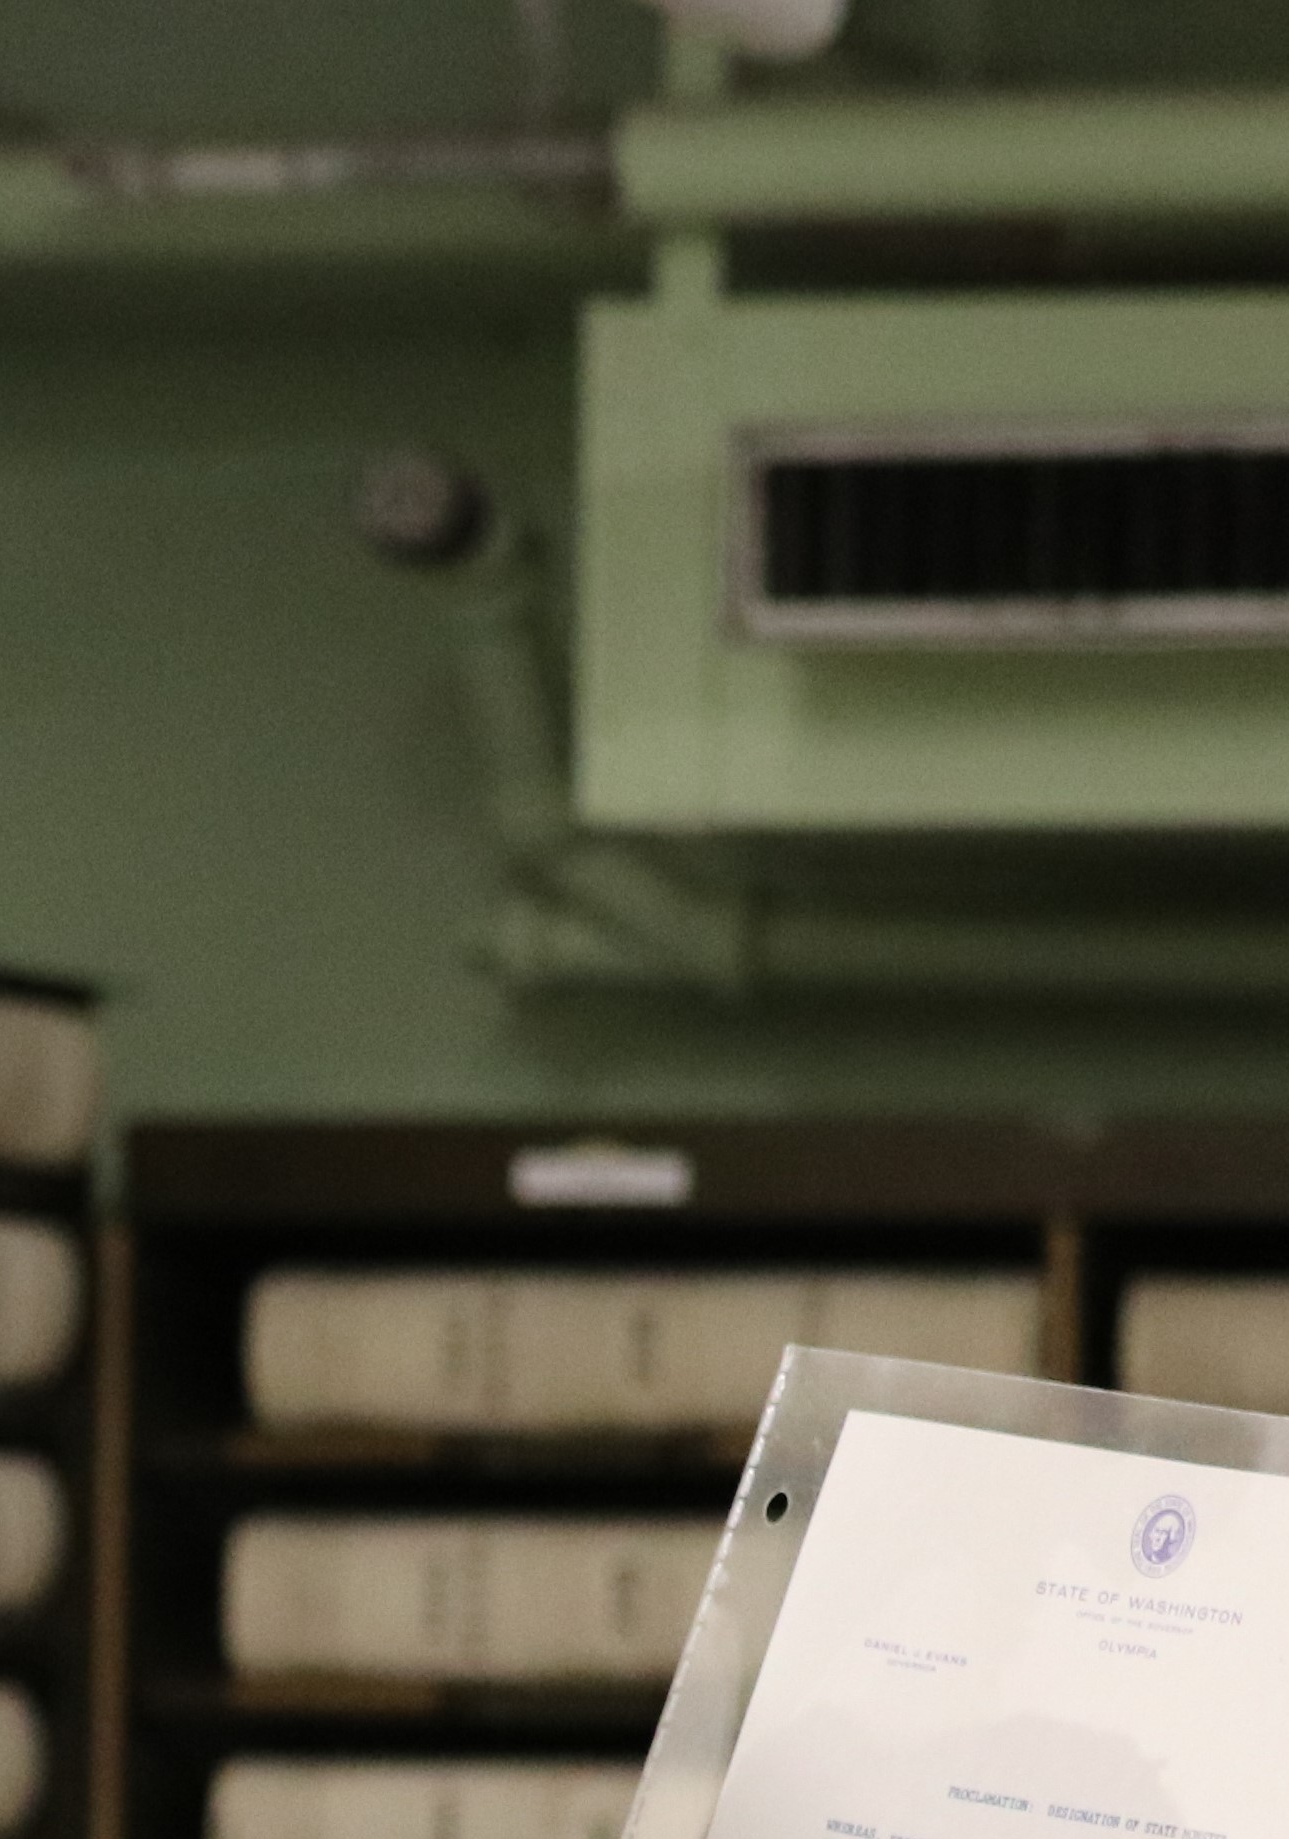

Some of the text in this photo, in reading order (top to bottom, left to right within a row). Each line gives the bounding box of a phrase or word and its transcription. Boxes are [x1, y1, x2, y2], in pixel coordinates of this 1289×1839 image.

[1035, 1581, 1243, 1626] STATE OF WASHINGTON
[863, 1638, 909, 1655] DANIEL
[926, 1650, 968, 1666] EVANS
[1098, 1639, 1159, 1660] OLYMPIA
[948, 1787, 1034, 1812] PROCLAMATION:
[1047, 1805, 1121, 1827] DESIGNATION
[1125, 1818, 1139, 1831] OF
[1144, 1822, 1178, 1838] STATE
